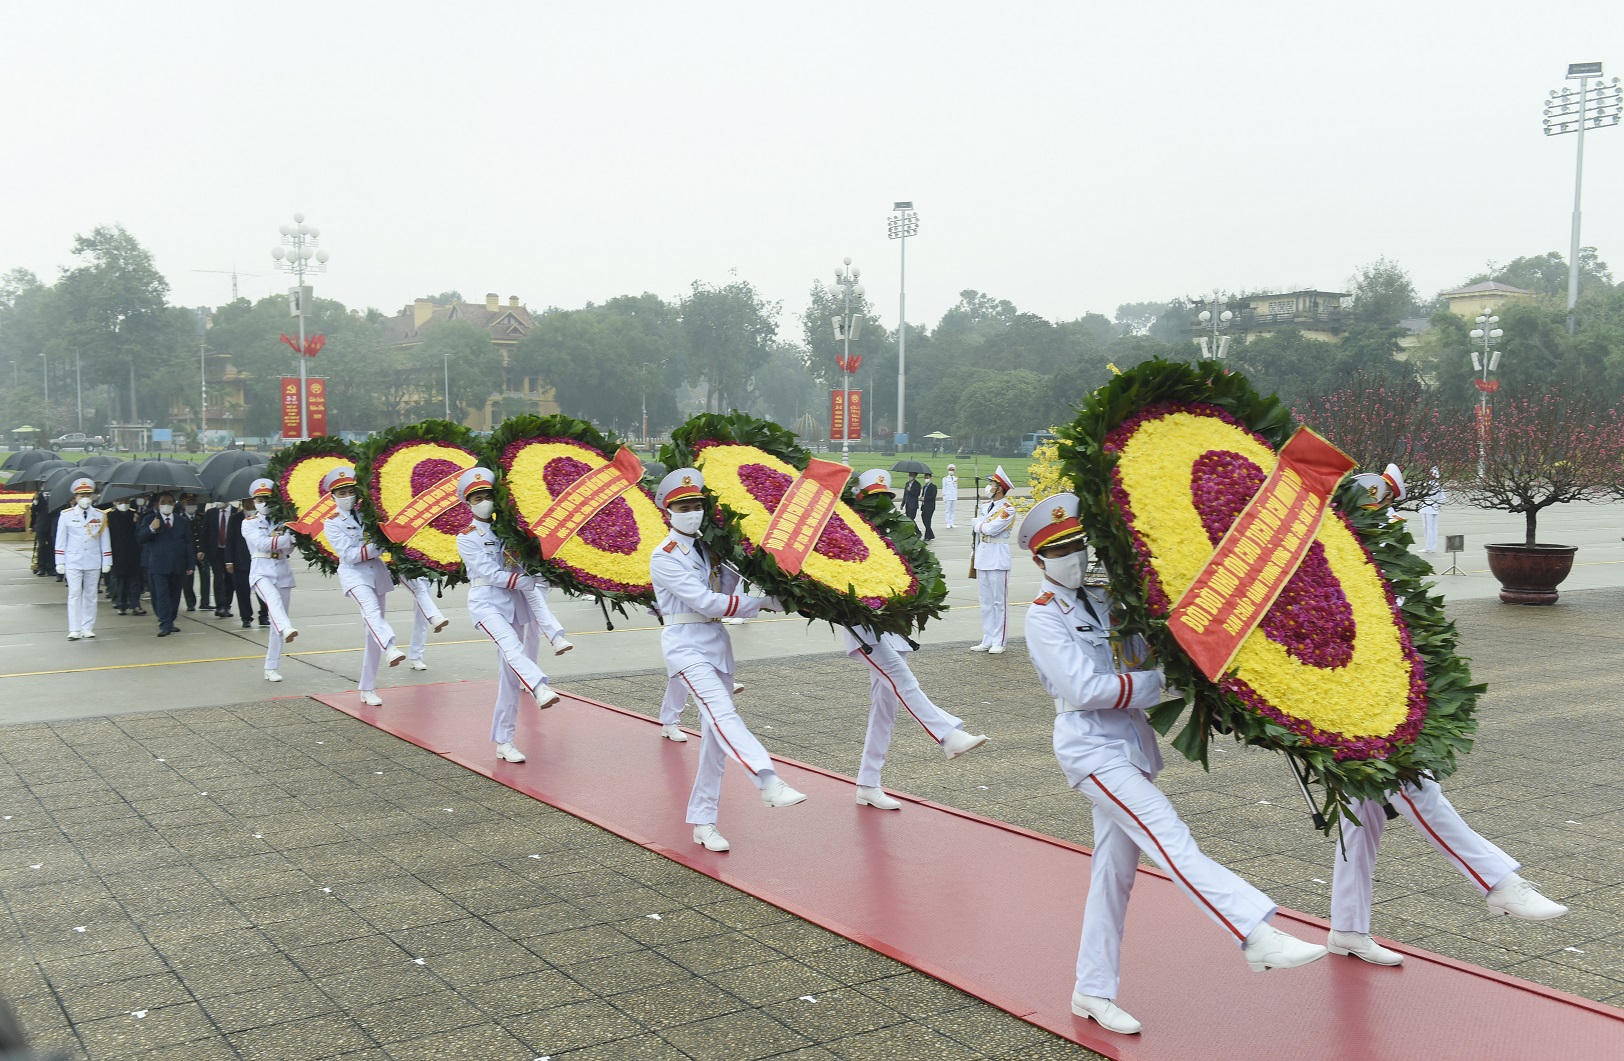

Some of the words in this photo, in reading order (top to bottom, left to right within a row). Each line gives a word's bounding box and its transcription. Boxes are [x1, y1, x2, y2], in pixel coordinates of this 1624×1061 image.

[1232, 531, 1262, 565] CHỦ
[1245, 520, 1274, 548] TỊCH
[1223, 553, 1251, 577] ƠN
[1208, 564, 1239, 598] NHỚ
[1194, 588, 1227, 615] ĐỜI
[1180, 608, 1213, 634] ĐỜI
[1222, 614, 1244, 636] BAN
[1235, 597, 1256, 621] CHẤP
